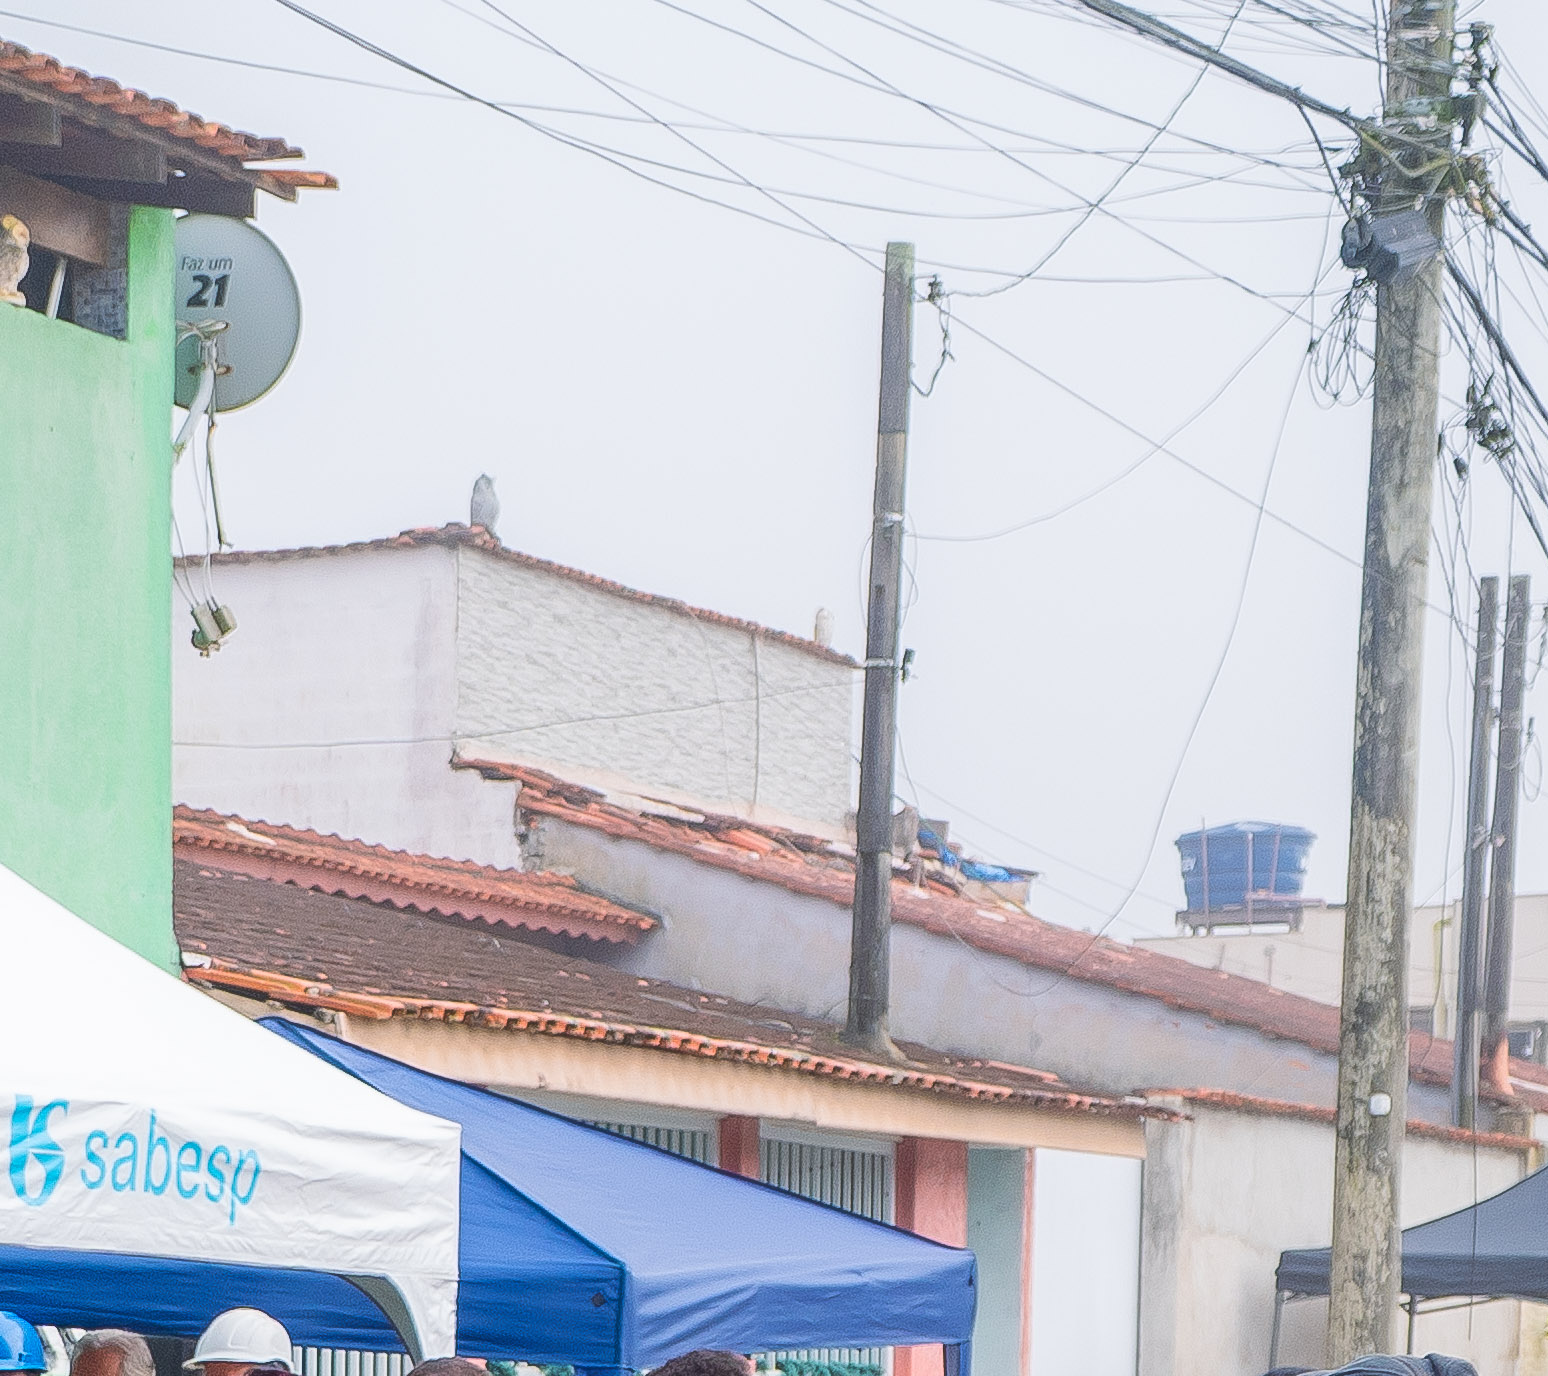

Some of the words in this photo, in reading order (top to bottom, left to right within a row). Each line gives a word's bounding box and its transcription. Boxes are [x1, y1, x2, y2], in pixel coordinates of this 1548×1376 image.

[208, 257, 233, 271] um
[186, 273, 231, 308] 21
[80, 1109, 262, 1226] sabesp
